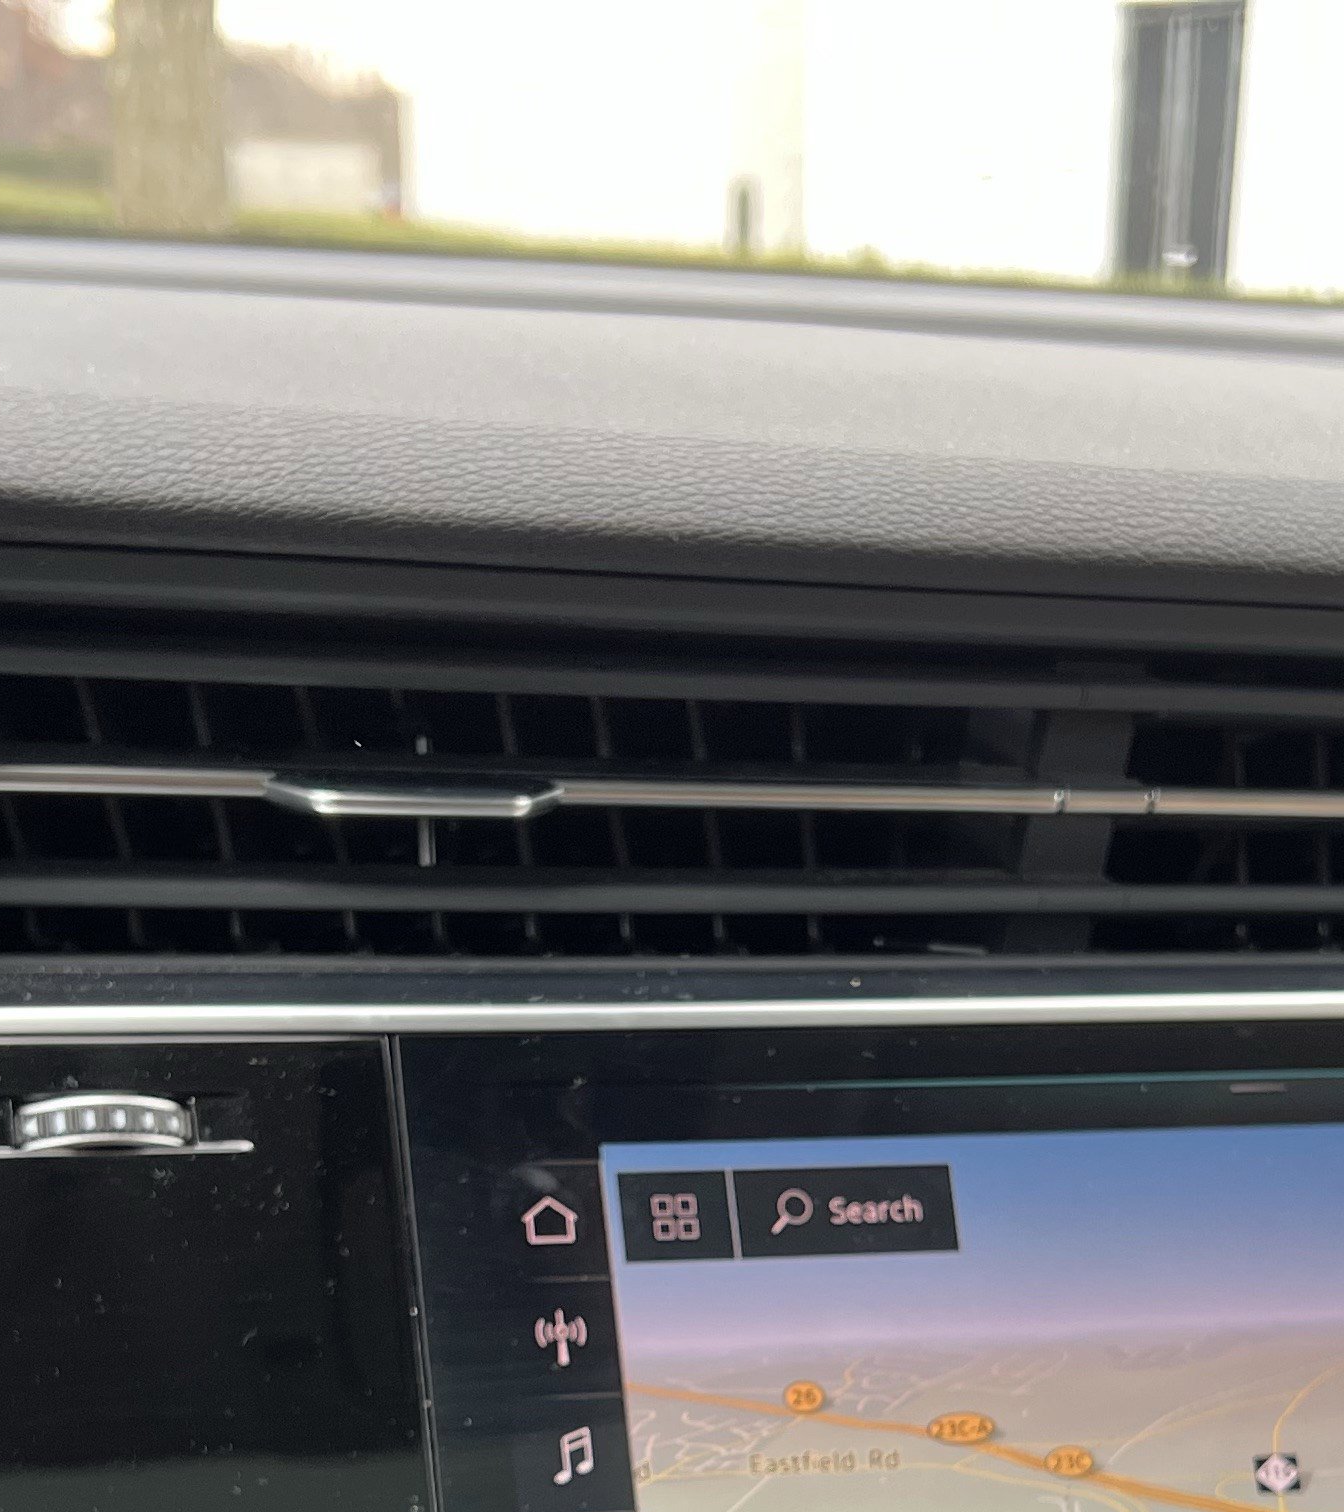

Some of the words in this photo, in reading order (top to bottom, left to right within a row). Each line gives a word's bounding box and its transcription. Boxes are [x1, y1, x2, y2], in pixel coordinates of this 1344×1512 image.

[828, 1194, 924, 1226] Search
[748, 1449, 857, 1476] Eastfield
[868, 1447, 901, 1472] Rd
